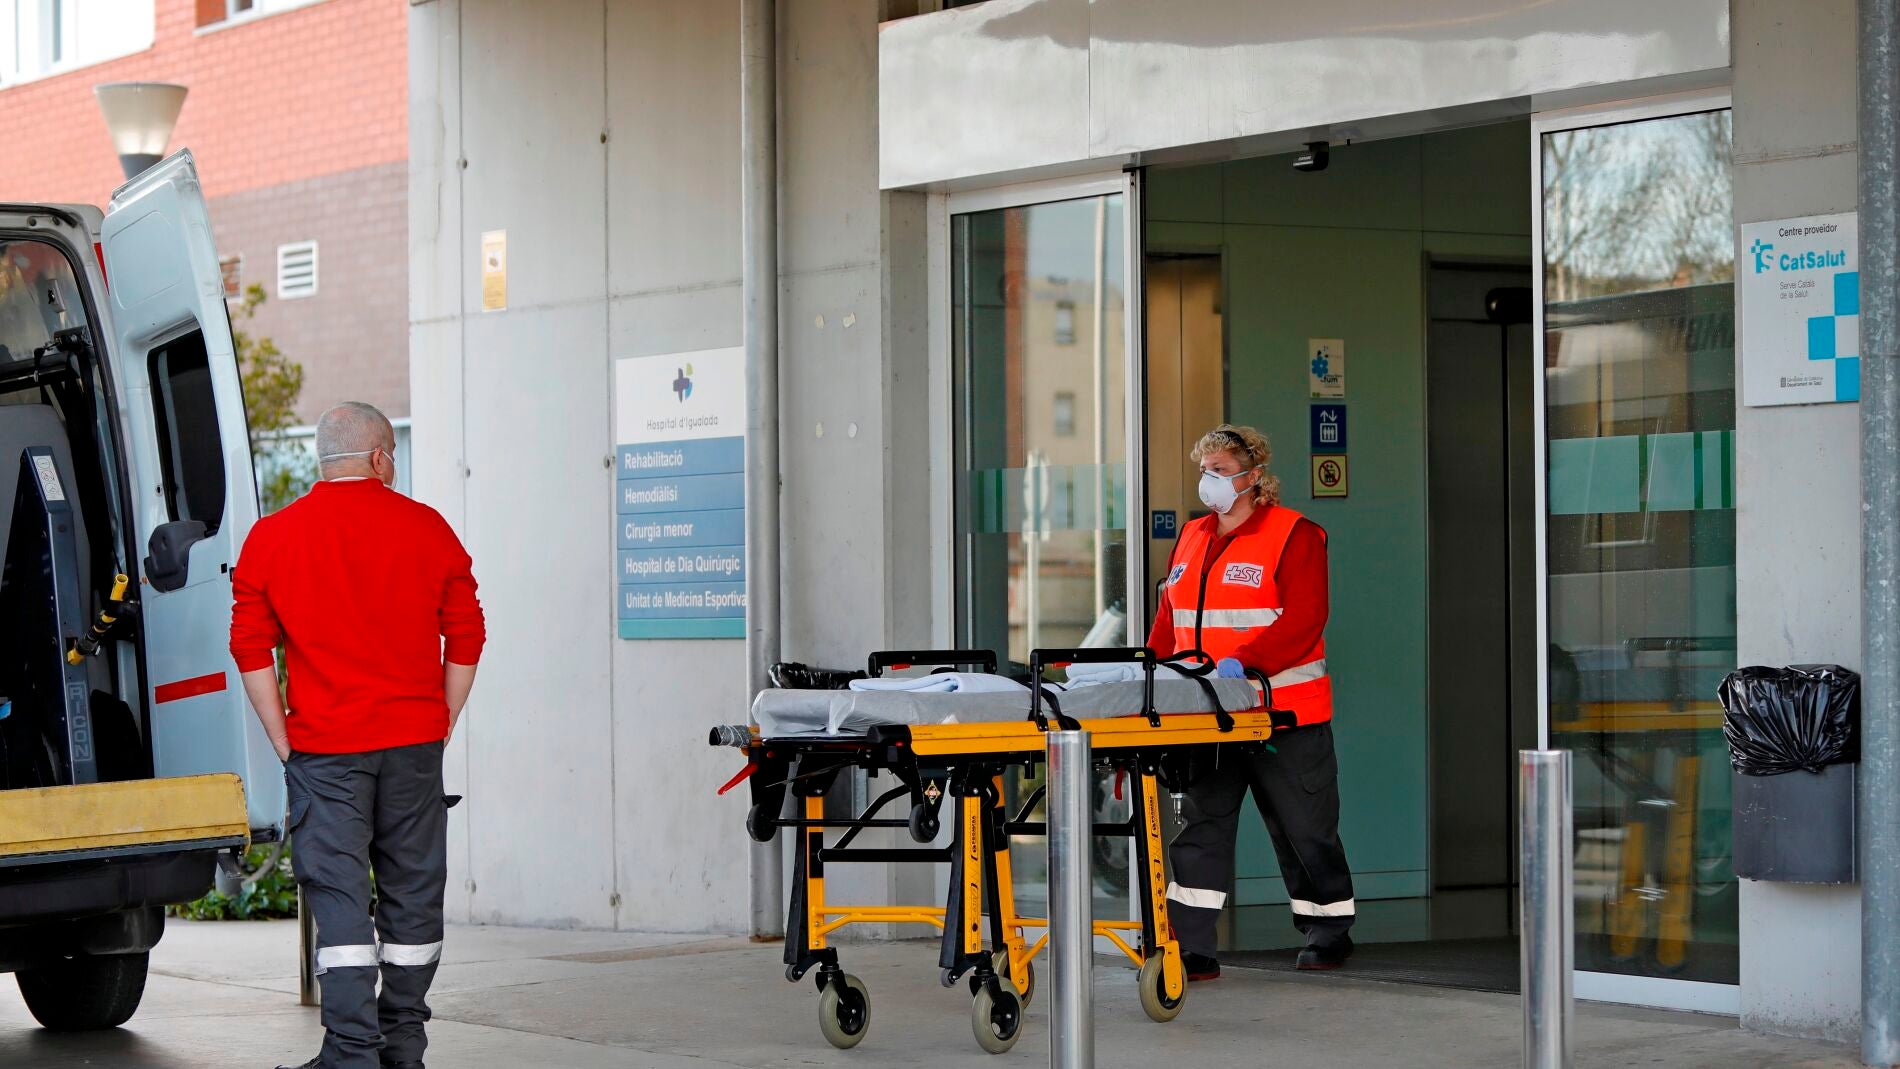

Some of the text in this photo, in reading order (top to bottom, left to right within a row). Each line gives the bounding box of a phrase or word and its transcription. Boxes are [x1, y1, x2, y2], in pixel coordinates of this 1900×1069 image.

[1778, 223, 1838, 238] Centre proveïdor
[1779, 249, 1846, 272] CatSalut
[646, 414, 719, 431] Hospital d'Igualada
[624, 449, 683, 470] Rehabilitació
[624, 485, 678, 504] Hemodiàlisi
[1154, 514, 1175, 529] PB
[625, 522, 694, 542] Cirurgia menor
[625, 554, 741, 577] Hospital de Dia Quirúrgic
[626, 590, 747, 611] Unitat de Medicina Esportiva
[69, 686, 89, 758] RICON
